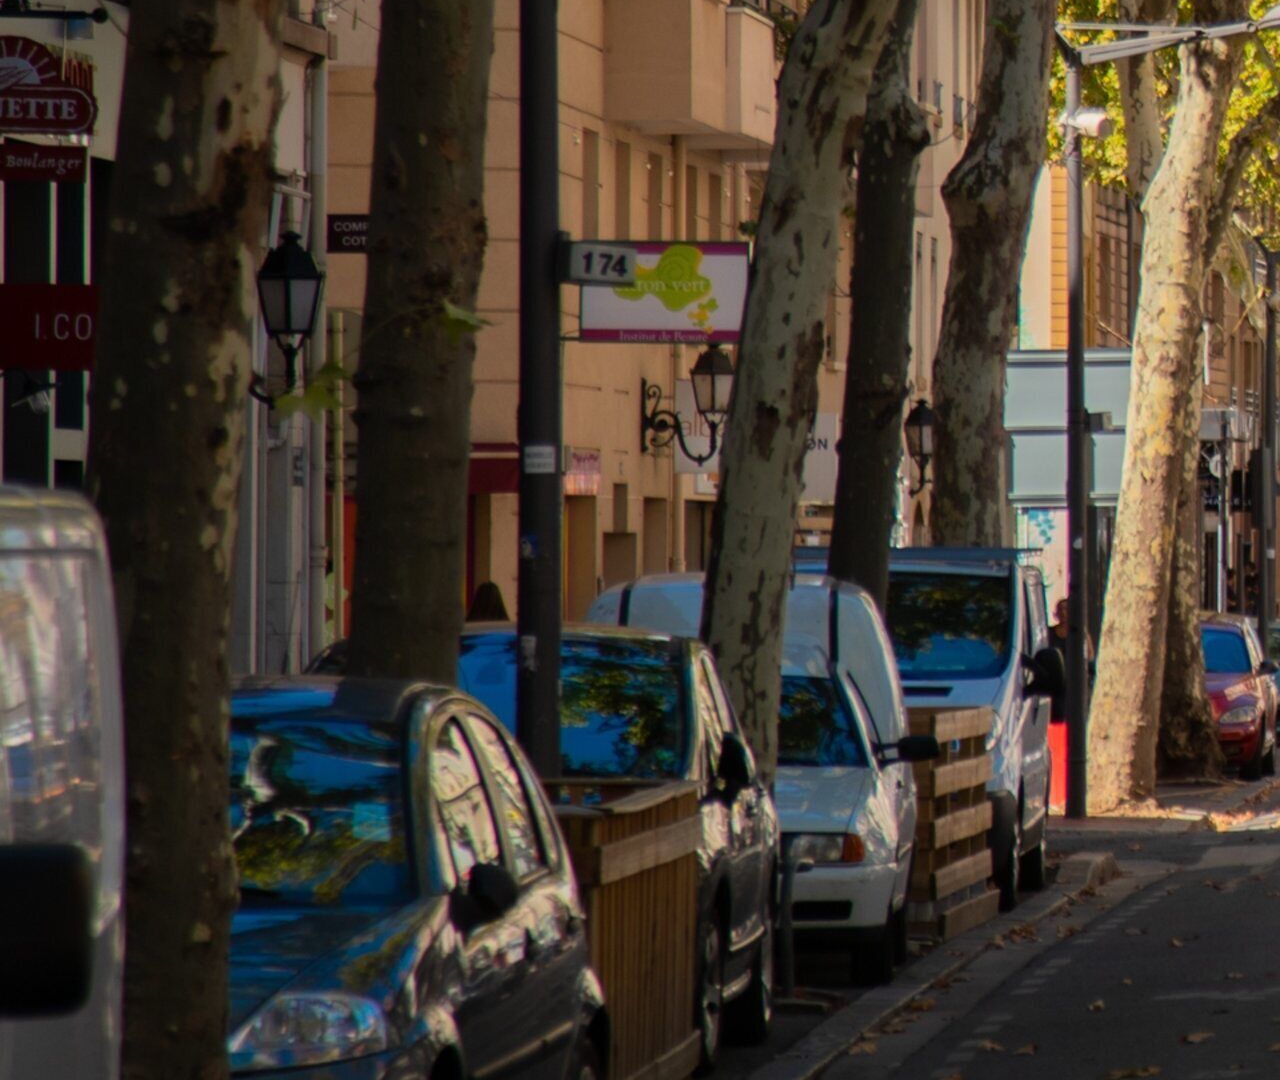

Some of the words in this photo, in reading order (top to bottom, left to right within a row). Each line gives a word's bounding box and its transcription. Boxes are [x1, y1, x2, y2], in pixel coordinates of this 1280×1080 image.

[5, 151, 82, 175] Boulanger
[582, 250, 628, 277] 174
[658, 330, 672, 342] de
